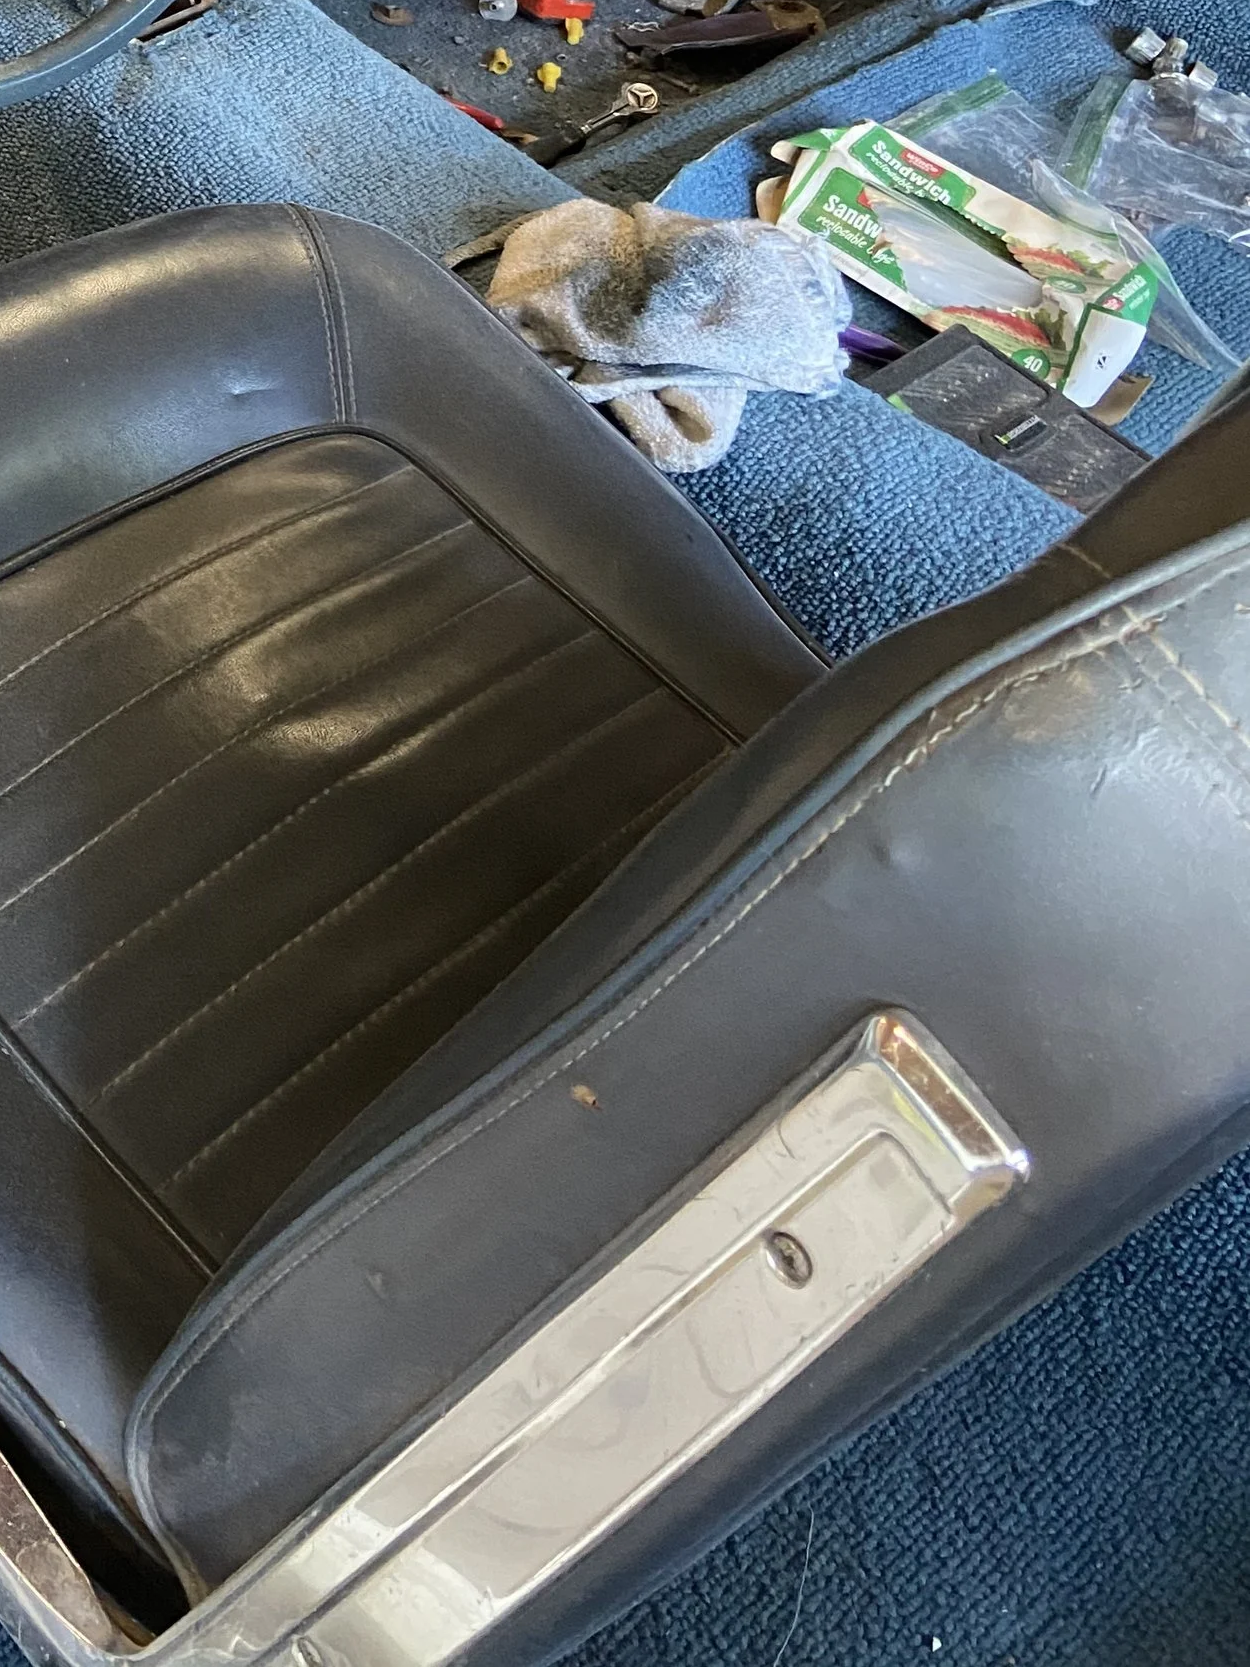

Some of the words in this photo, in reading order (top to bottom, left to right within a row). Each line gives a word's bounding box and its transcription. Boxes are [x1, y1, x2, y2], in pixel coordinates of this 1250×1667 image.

[871, 139, 952, 205] Sandwich
[815, 215, 867, 248] reclosable
[822, 194, 883, 239] Sandw
[1022, 354, 1043, 373] 40
